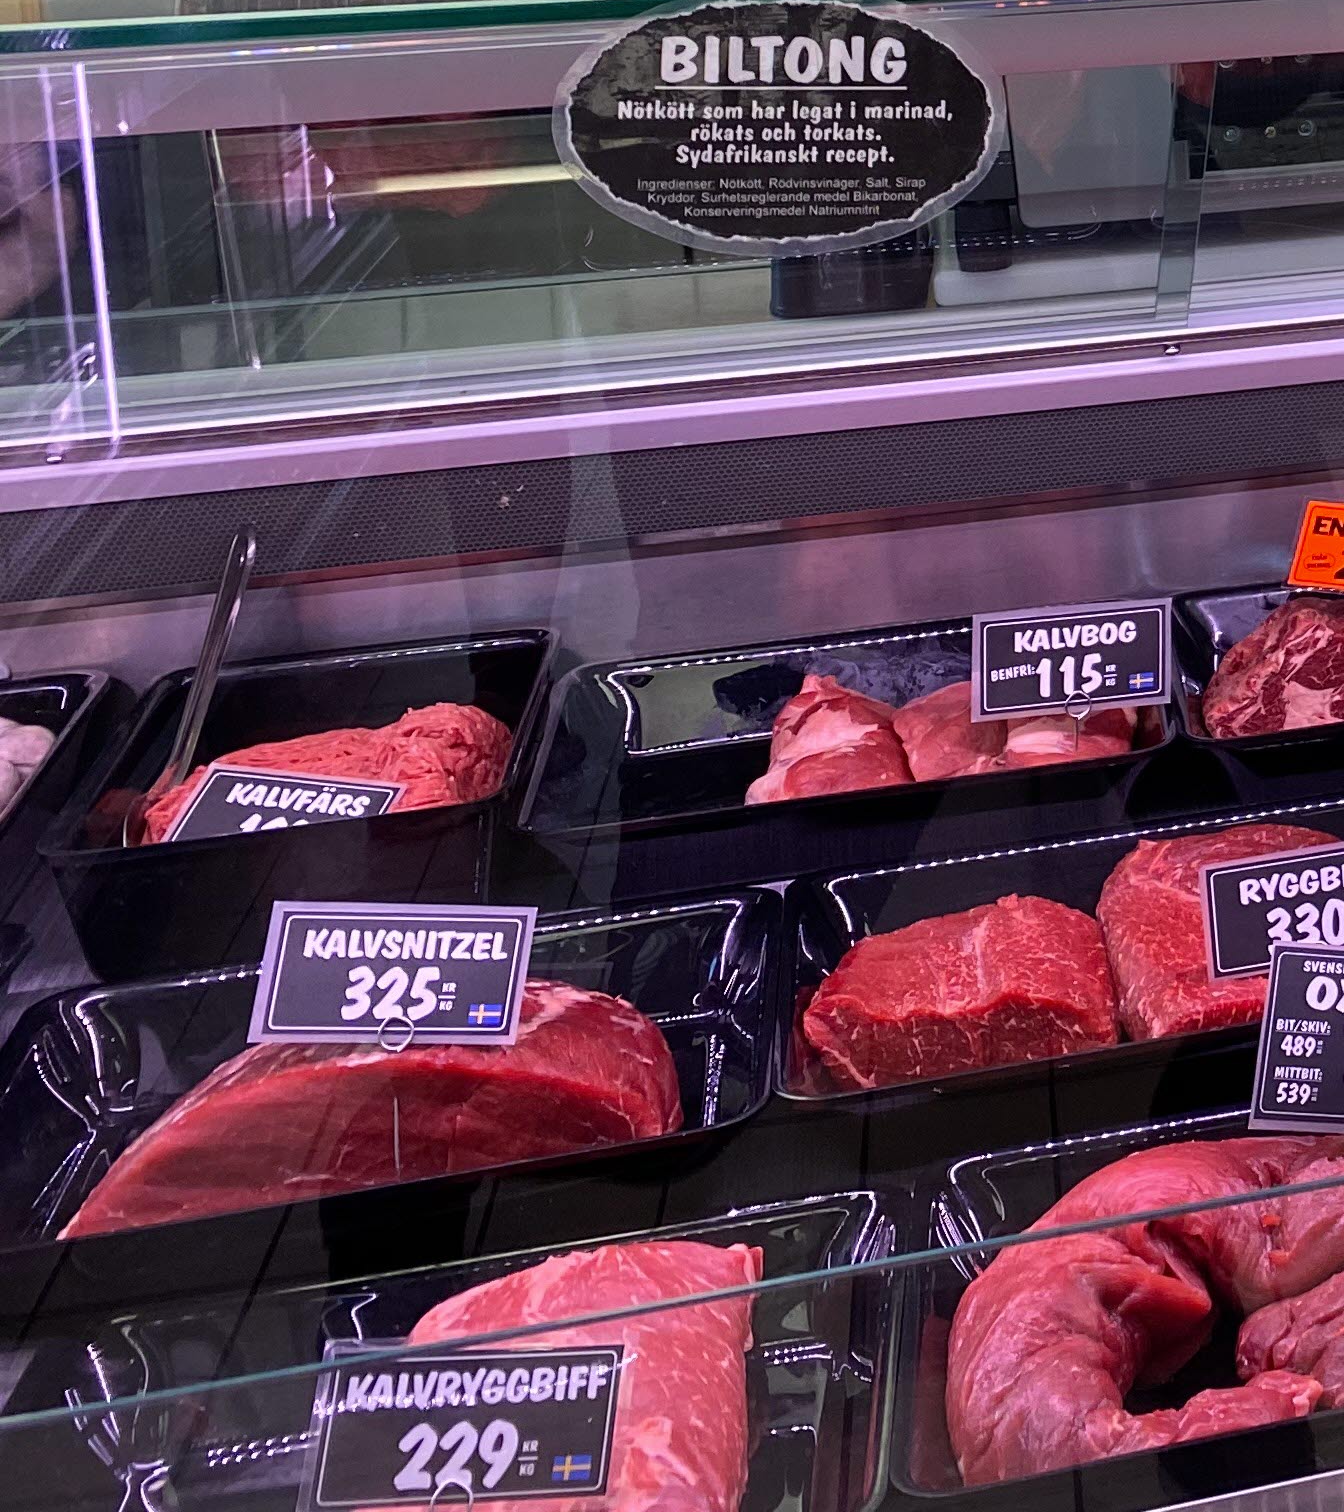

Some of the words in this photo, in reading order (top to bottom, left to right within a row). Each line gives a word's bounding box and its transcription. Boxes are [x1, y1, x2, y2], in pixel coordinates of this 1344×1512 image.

[660, 35, 908, 85] BILTONG
[617, 101, 696, 120] Nötkött
[702, 104, 743, 120] som
[751, 102, 785, 120] har
[792, 101, 842, 125] legat
[850, 101, 857, 120] i
[863, 100, 953, 123] marinad,
[690, 124, 754, 143] rökats
[761, 124, 796, 142] och
[804, 123, 882, 143] torkats.
[675, 144, 819, 169] Sydafrikanskt
[825, 145, 895, 168] recept.
[1014, 620, 1137, 654] KALVBOG
[990, 663, 1036, 683] BENFRI:
[1036, 652, 1103, 698] 115
[225, 782, 371, 817] KALVFÄRS
[303, 928, 508, 961] KALVSNITZEL
[340, 965, 441, 1021] 325
[1275, 1018, 1332, 1035] BIT/SKIV:
[1280, 1034, 1317, 1058] 489
[1274, 1066, 1323, 1081] MITTBIT:
[1276, 1082, 1312, 1105] 539
[346, 1363, 609, 1413] KALVRYGGBIFF
[393, 1418, 519, 1491] 229
